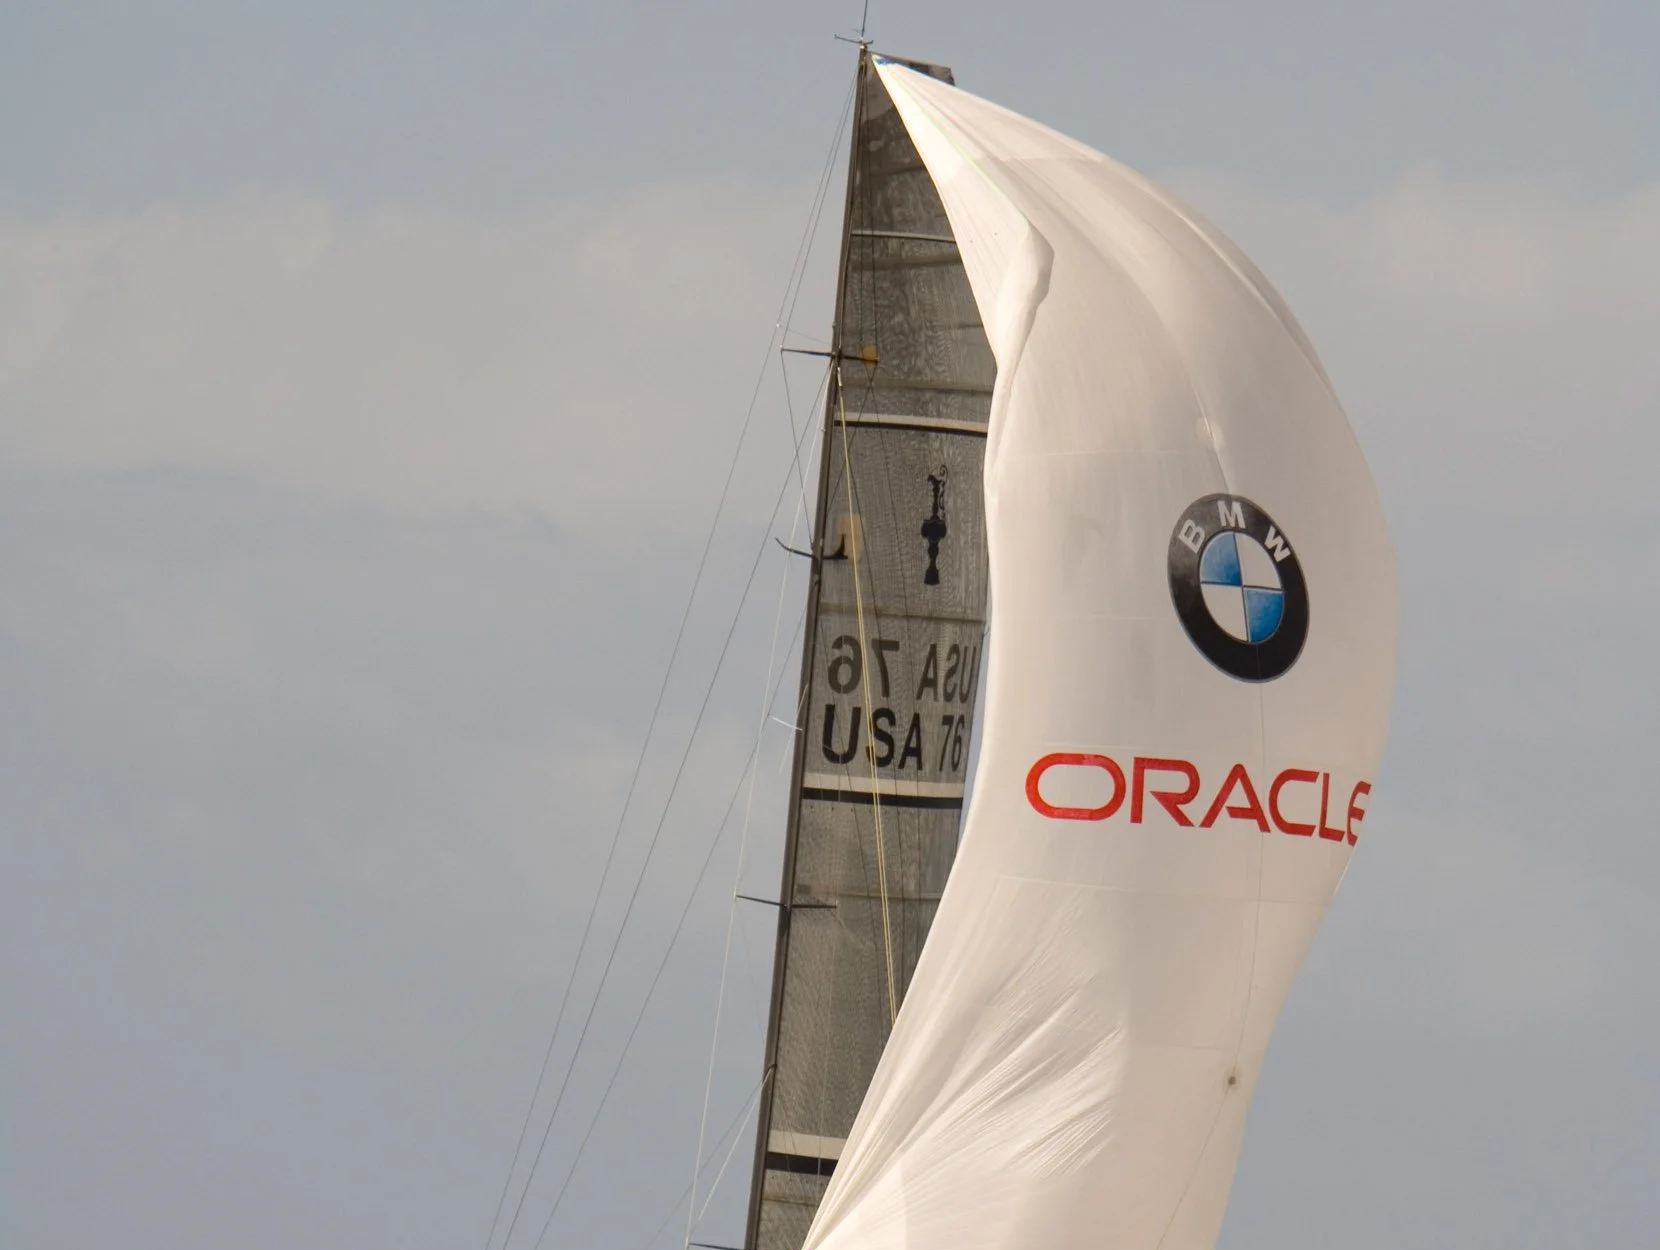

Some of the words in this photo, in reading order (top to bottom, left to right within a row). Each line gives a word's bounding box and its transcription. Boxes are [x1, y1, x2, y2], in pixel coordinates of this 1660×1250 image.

[1178, 501, 1291, 562] BMW
[822, 704, 923, 771] USA
[939, 714, 966, 772] 76
[1025, 752, 1372, 847] ORACLE
